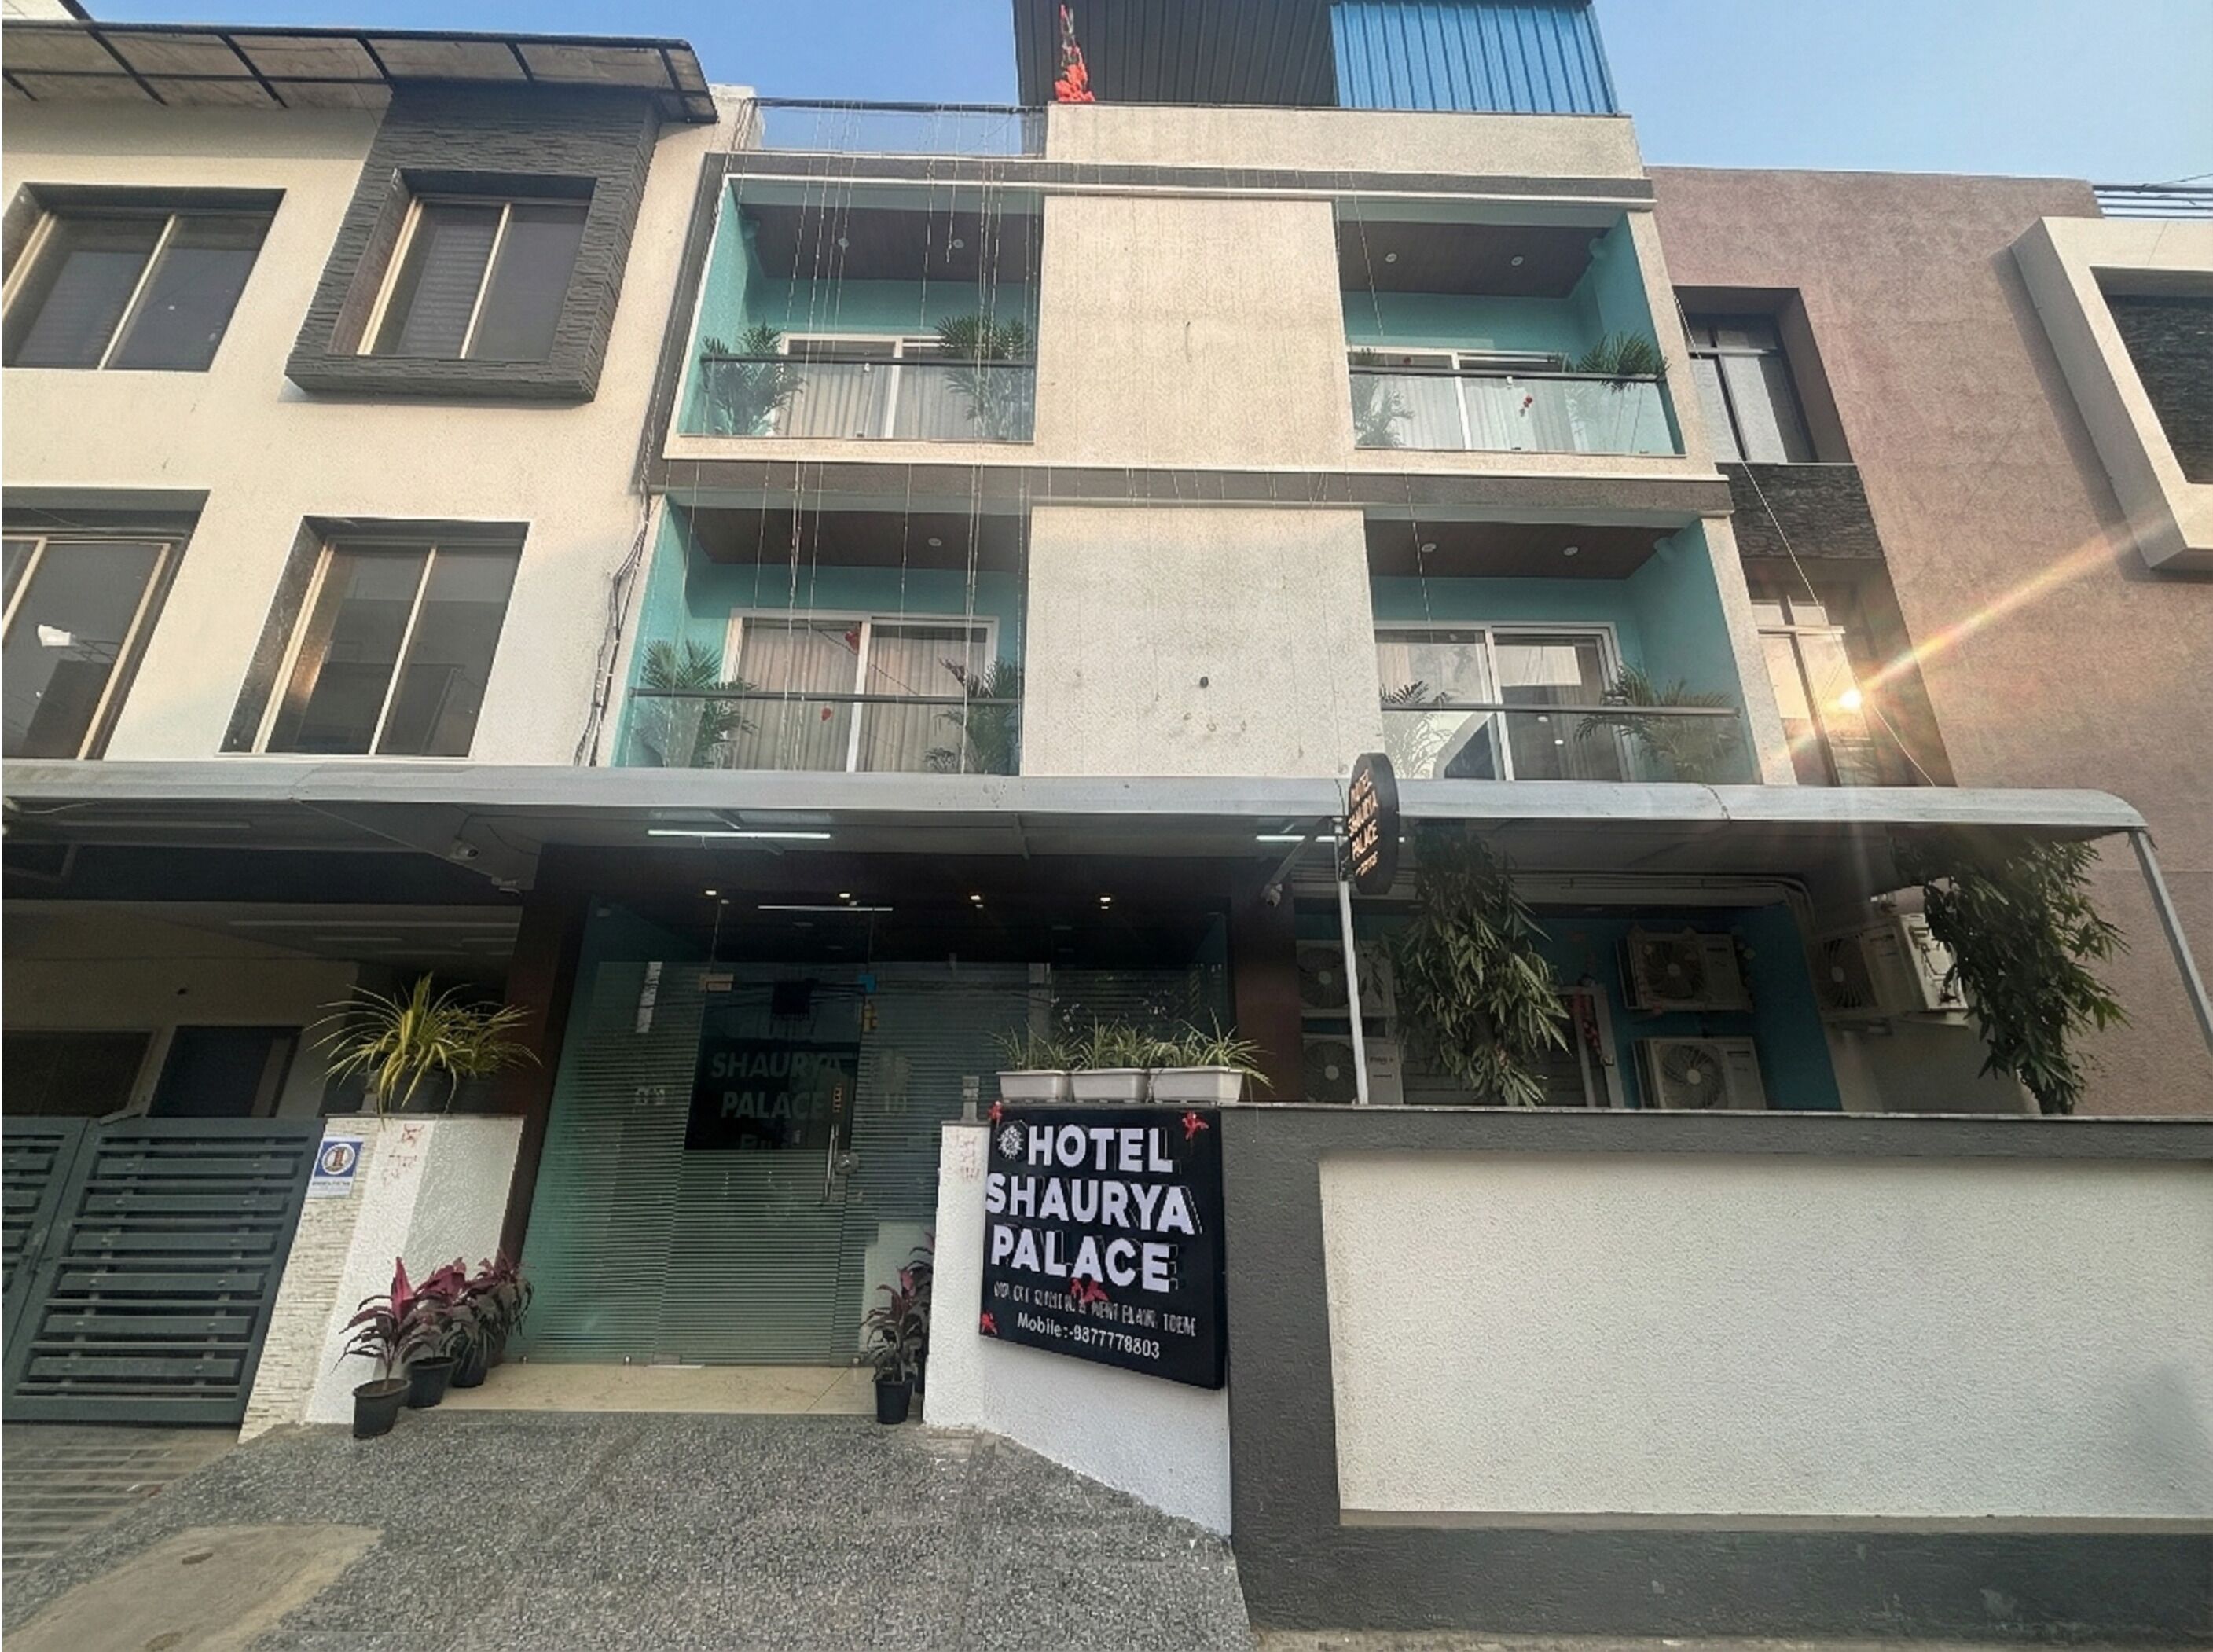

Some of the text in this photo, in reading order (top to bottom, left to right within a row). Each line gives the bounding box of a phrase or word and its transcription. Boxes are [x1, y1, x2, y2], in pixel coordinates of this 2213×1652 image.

[1028, 1125, 1173, 1173] HOTEL
[985, 1173, 1198, 1235] SHAURYA
[990, 1224, 1171, 1293] PALACE
